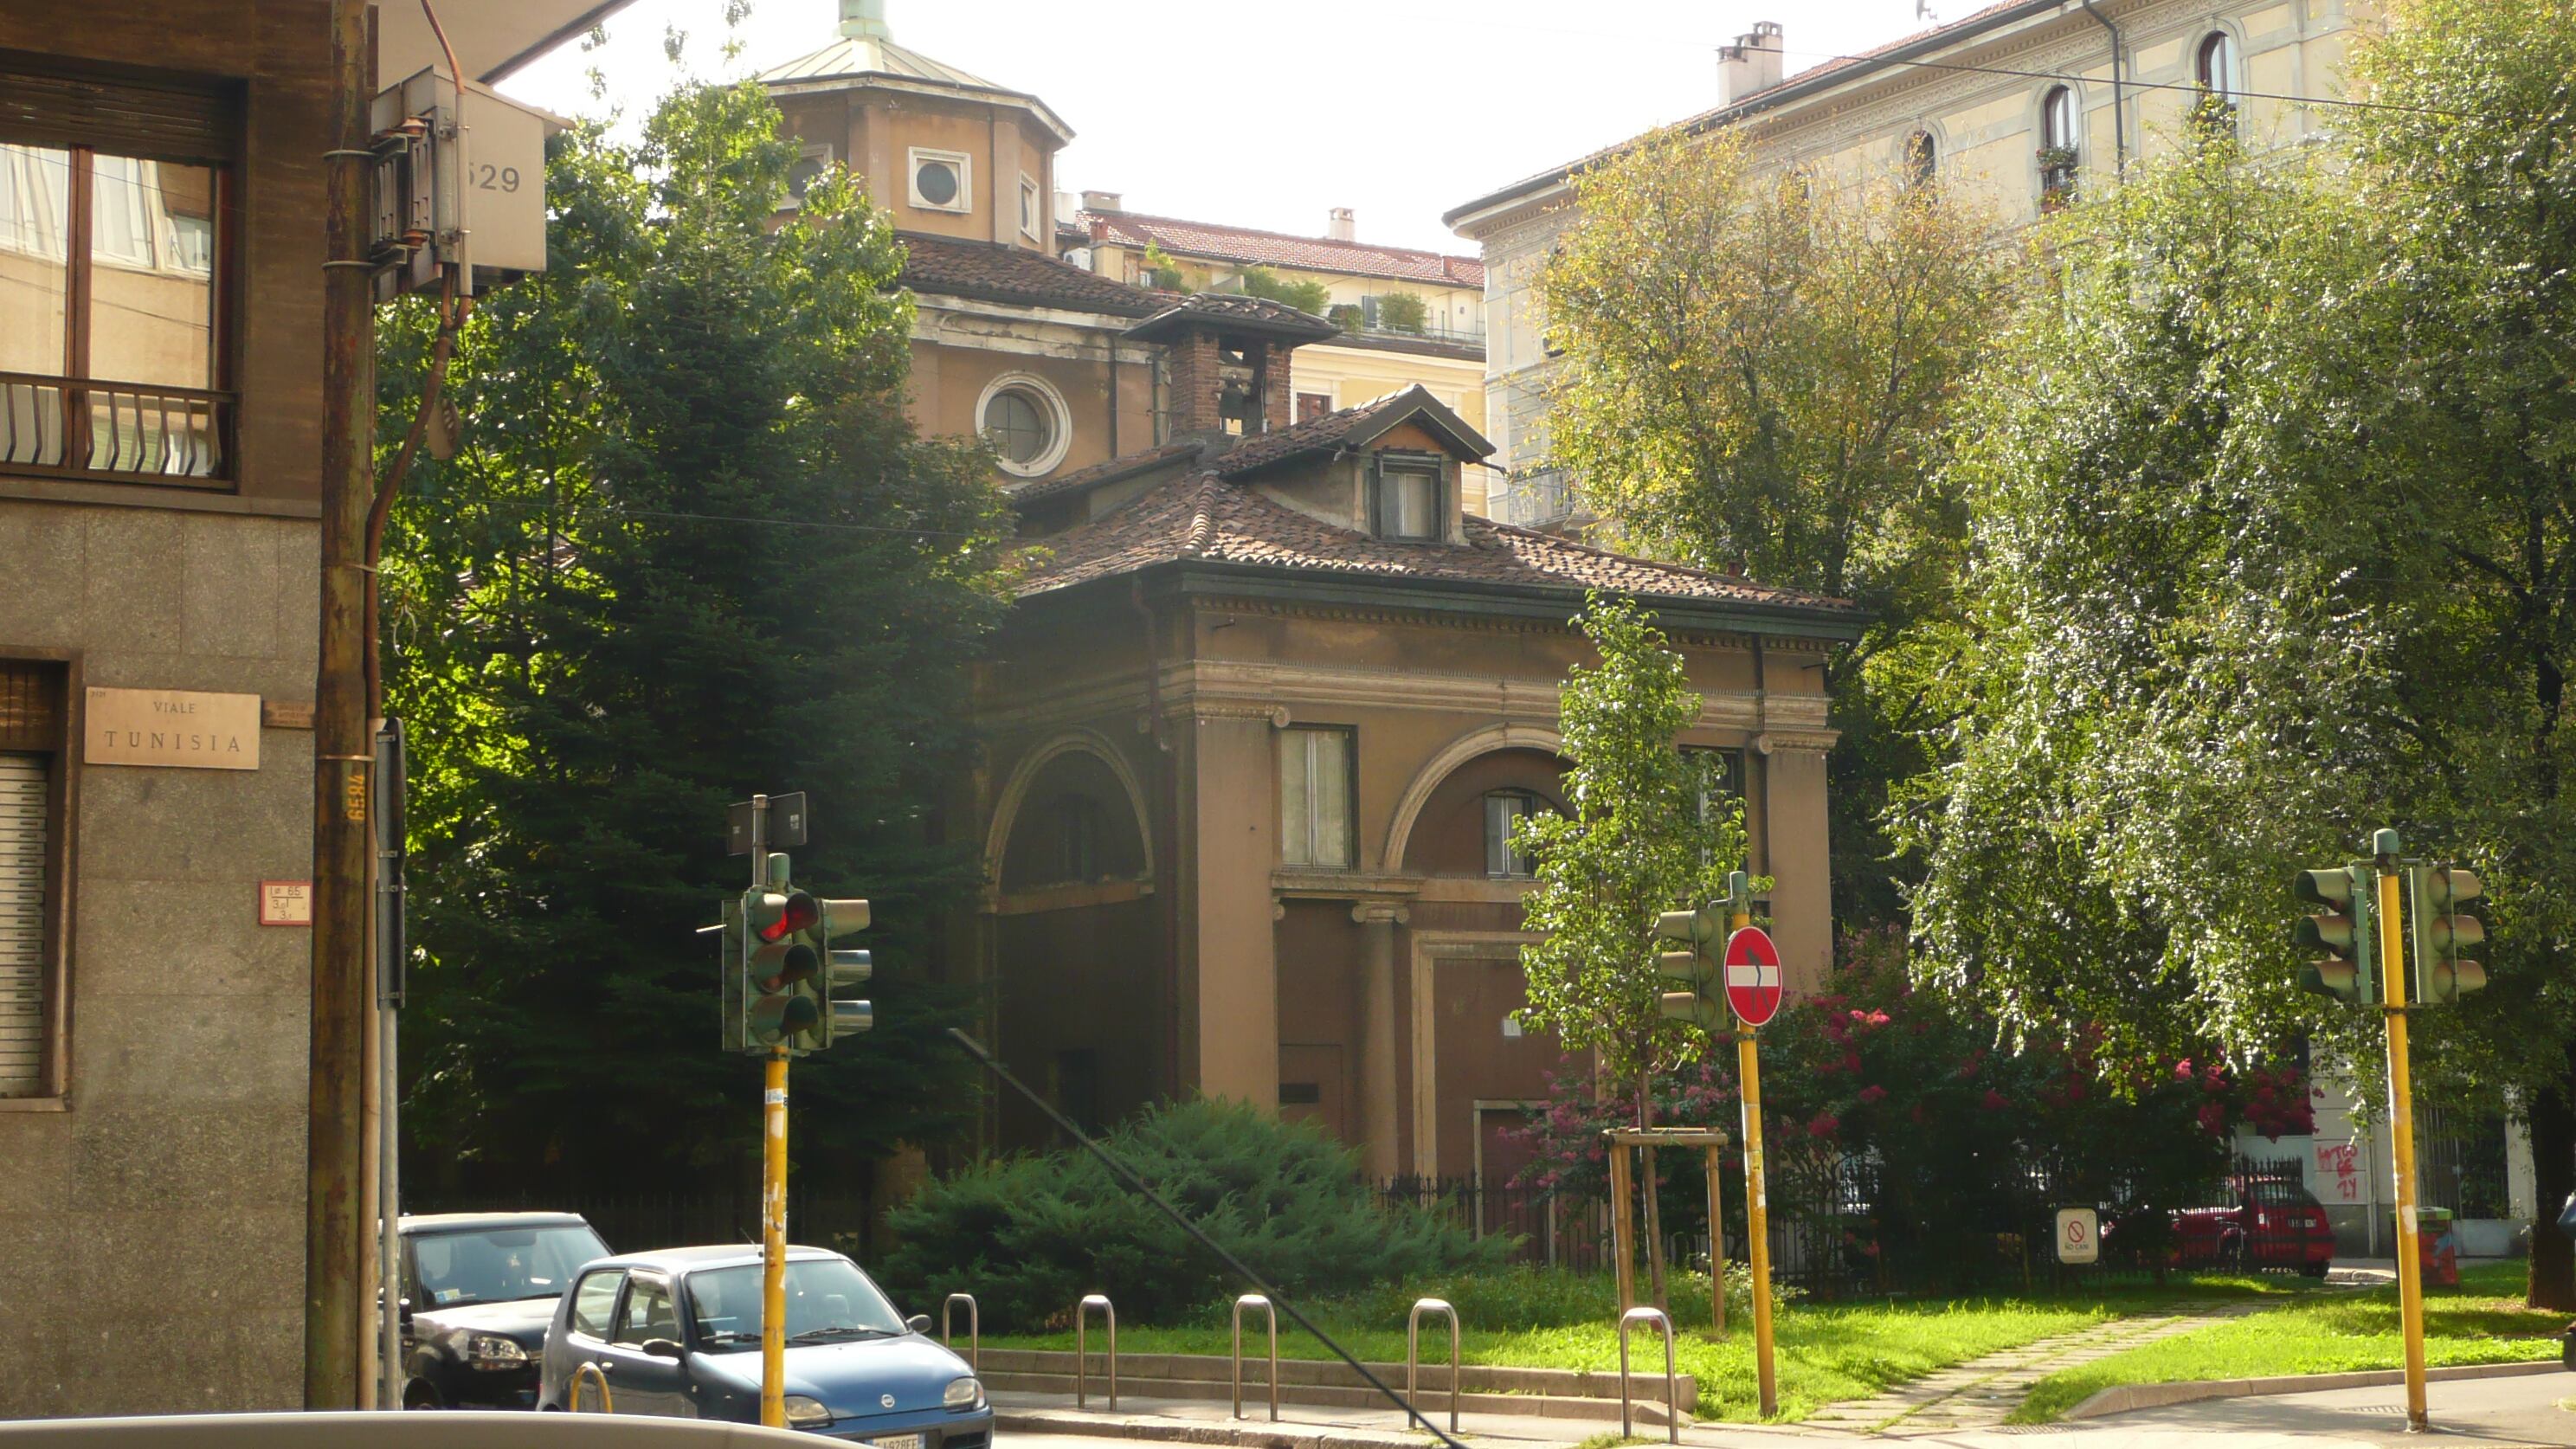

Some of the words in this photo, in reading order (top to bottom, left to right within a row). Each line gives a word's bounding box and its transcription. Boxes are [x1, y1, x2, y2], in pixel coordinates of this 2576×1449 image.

[153, 701, 196, 714] VIALE
[104, 731, 241, 753] TUNISIA
[346, 775, 365, 821] 6584
